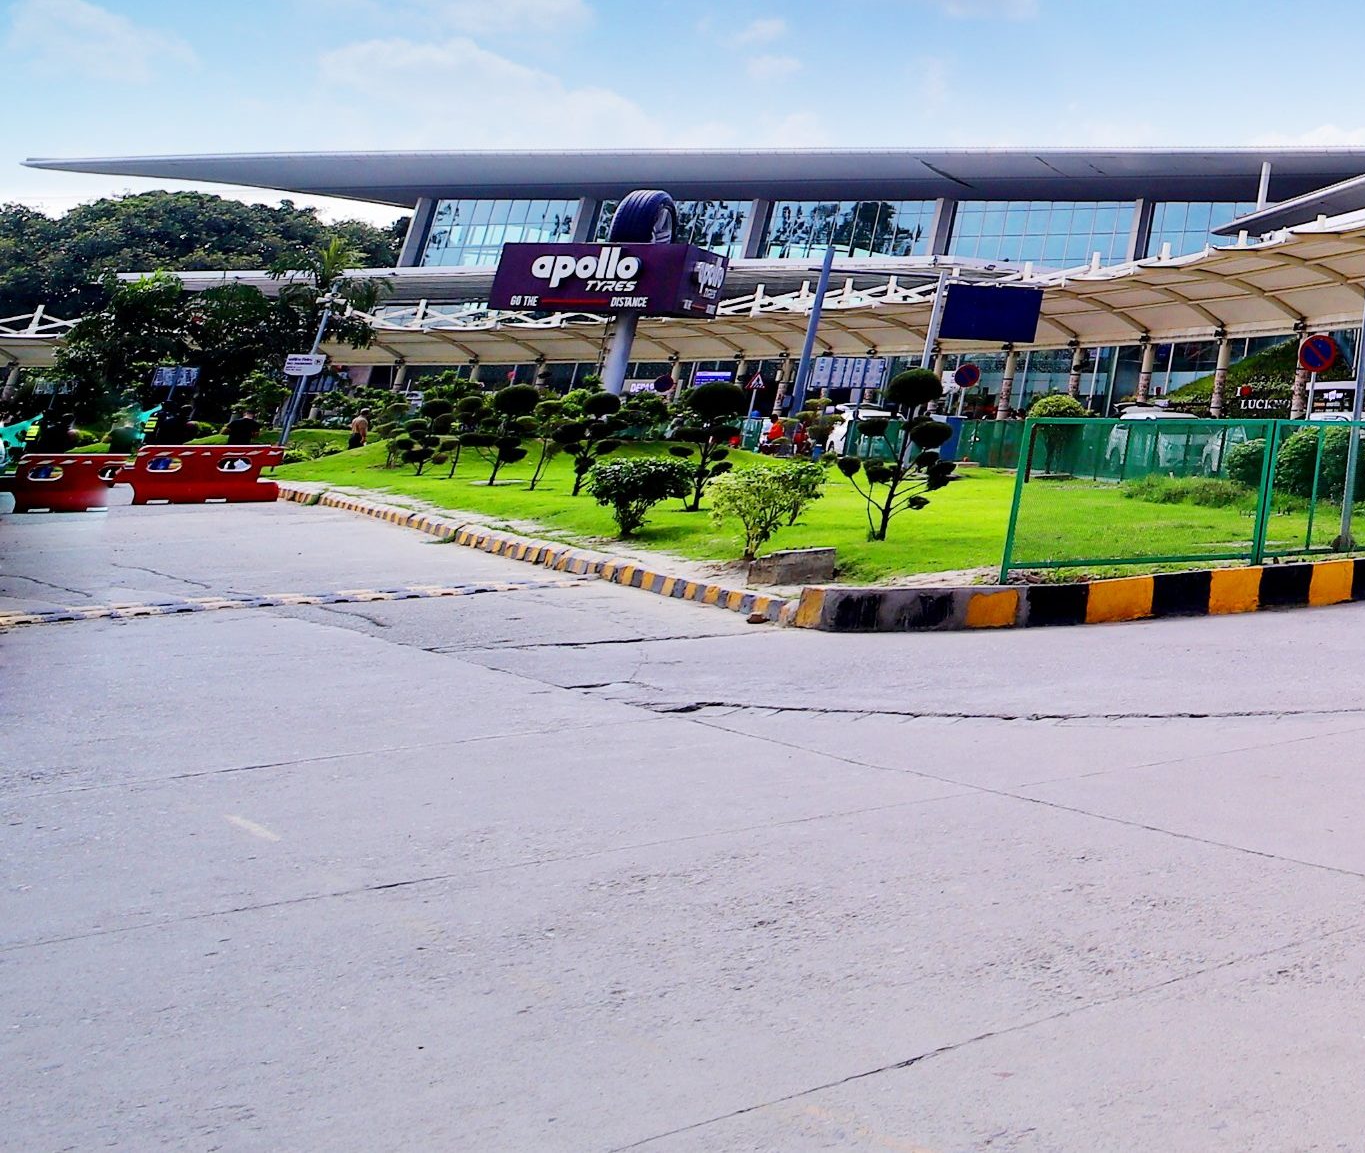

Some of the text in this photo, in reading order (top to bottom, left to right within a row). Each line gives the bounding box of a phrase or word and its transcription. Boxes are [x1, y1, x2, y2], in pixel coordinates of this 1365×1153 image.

[531, 246, 640, 288] apollo
[585, 280, 637, 292] TYRES
[510, 296, 648, 308] GO THE DISTANCE
[1240, 399, 1291, 410] LUCKNO
